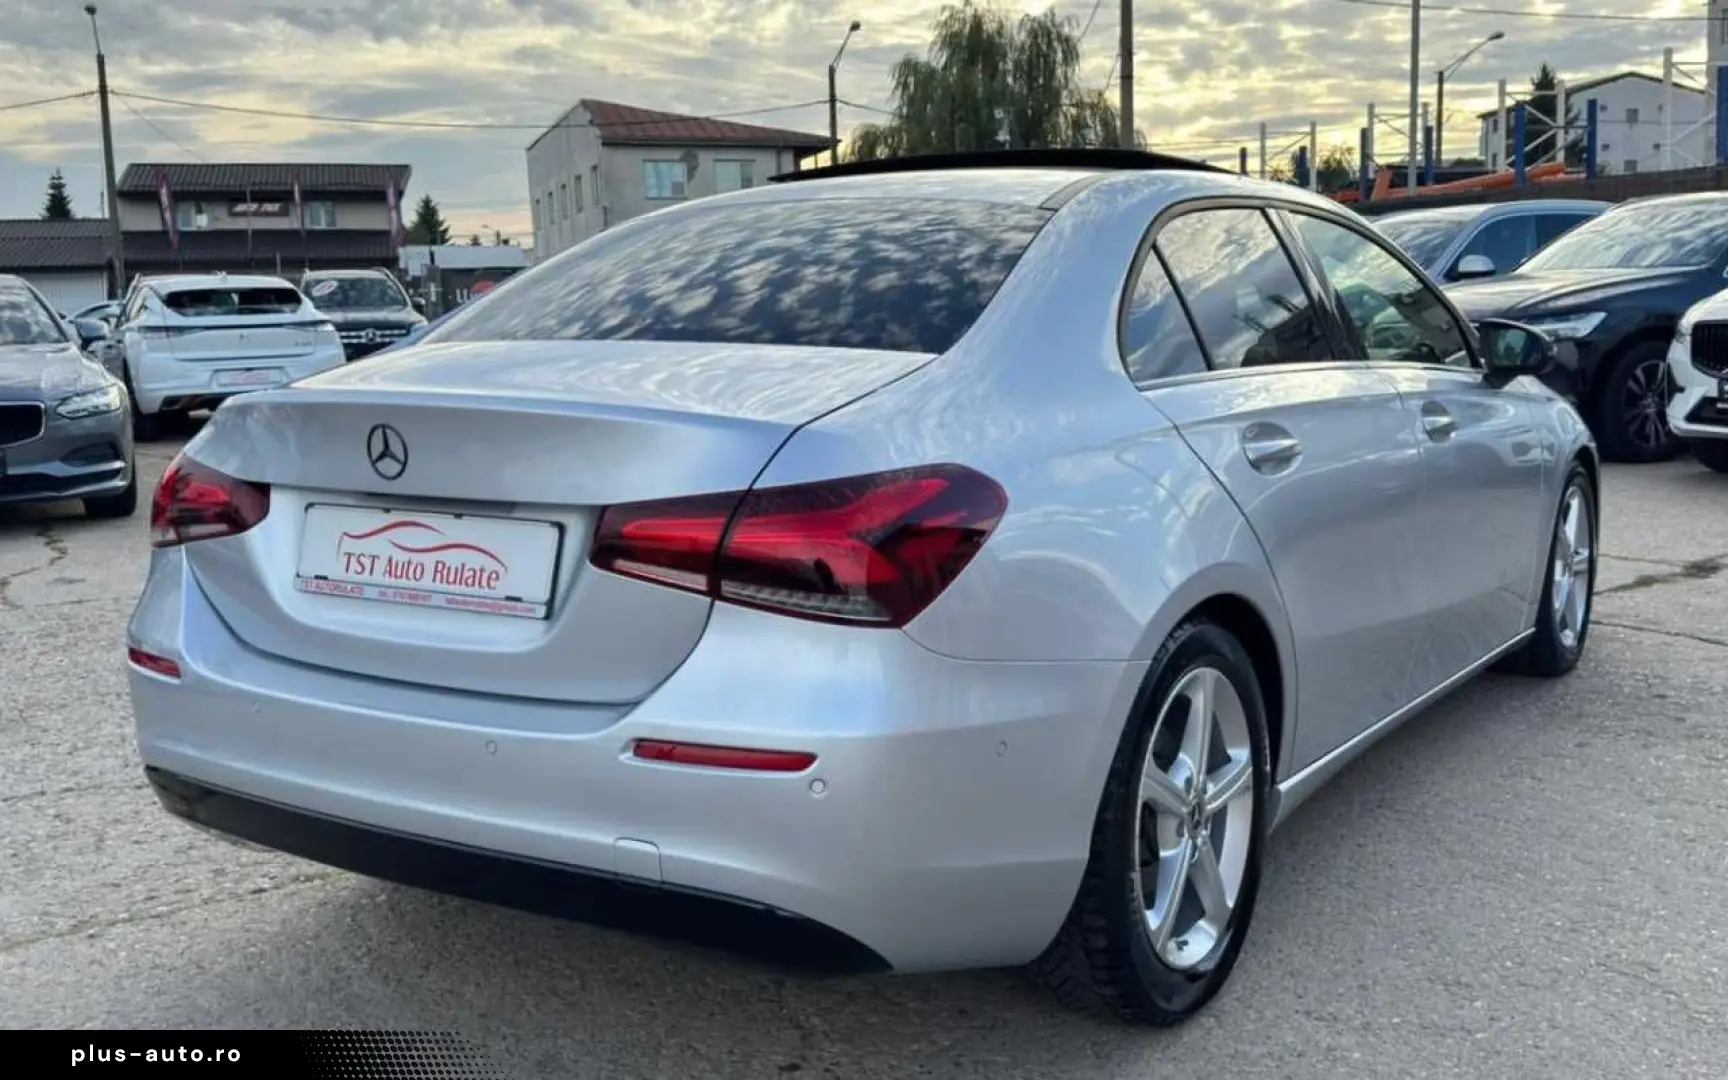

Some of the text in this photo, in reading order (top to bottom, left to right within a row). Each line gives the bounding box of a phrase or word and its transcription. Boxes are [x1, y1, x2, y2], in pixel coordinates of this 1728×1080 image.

[343, 551, 500, 591] TST Auto Rulate
